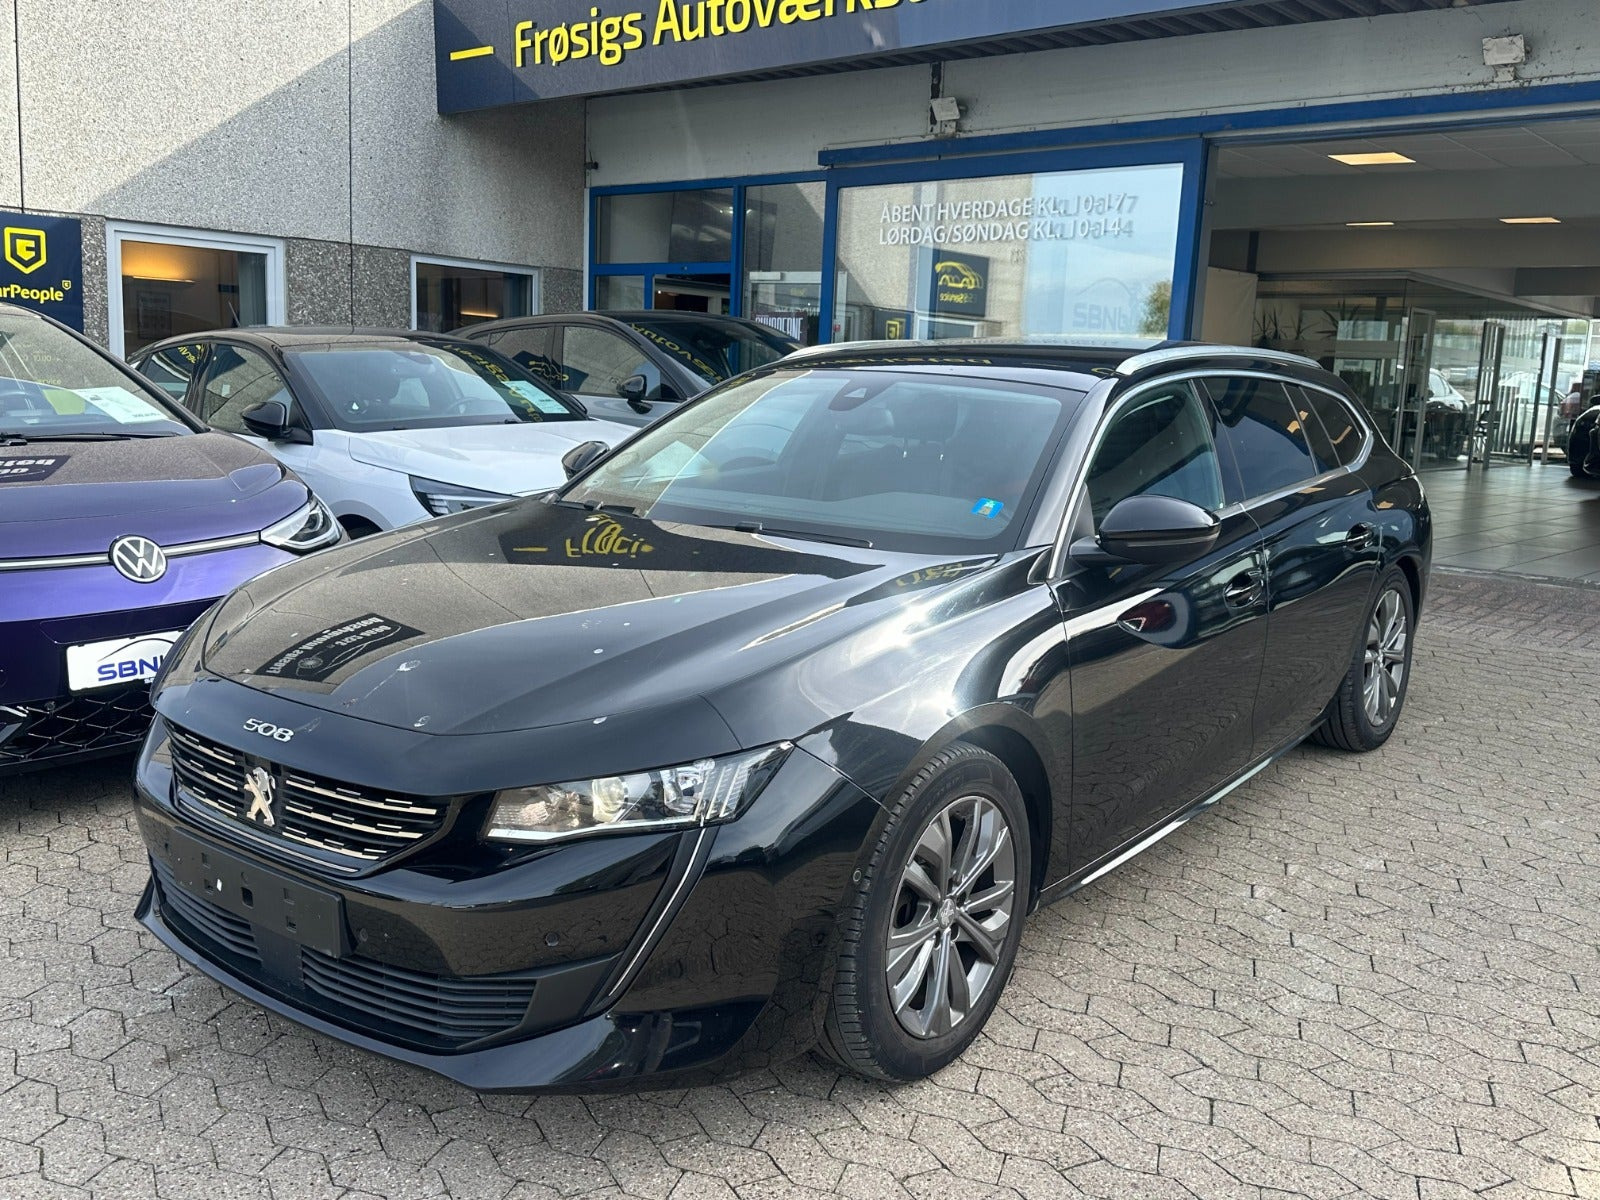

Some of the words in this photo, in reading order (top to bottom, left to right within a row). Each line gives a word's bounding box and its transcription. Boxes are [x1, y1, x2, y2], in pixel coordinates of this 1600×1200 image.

[515, 11, 644, 67] Frøsigs
[652, 0, 930, 45] Autovær
[880, 202, 934, 223] ÅBENT
[937, 197, 1033, 221] HVERDAGE
[879, 221, 1029, 245] LØRDAG/SØNDAG
[97, 654, 164, 682] SBN
[243, 718, 294, 743] 508
